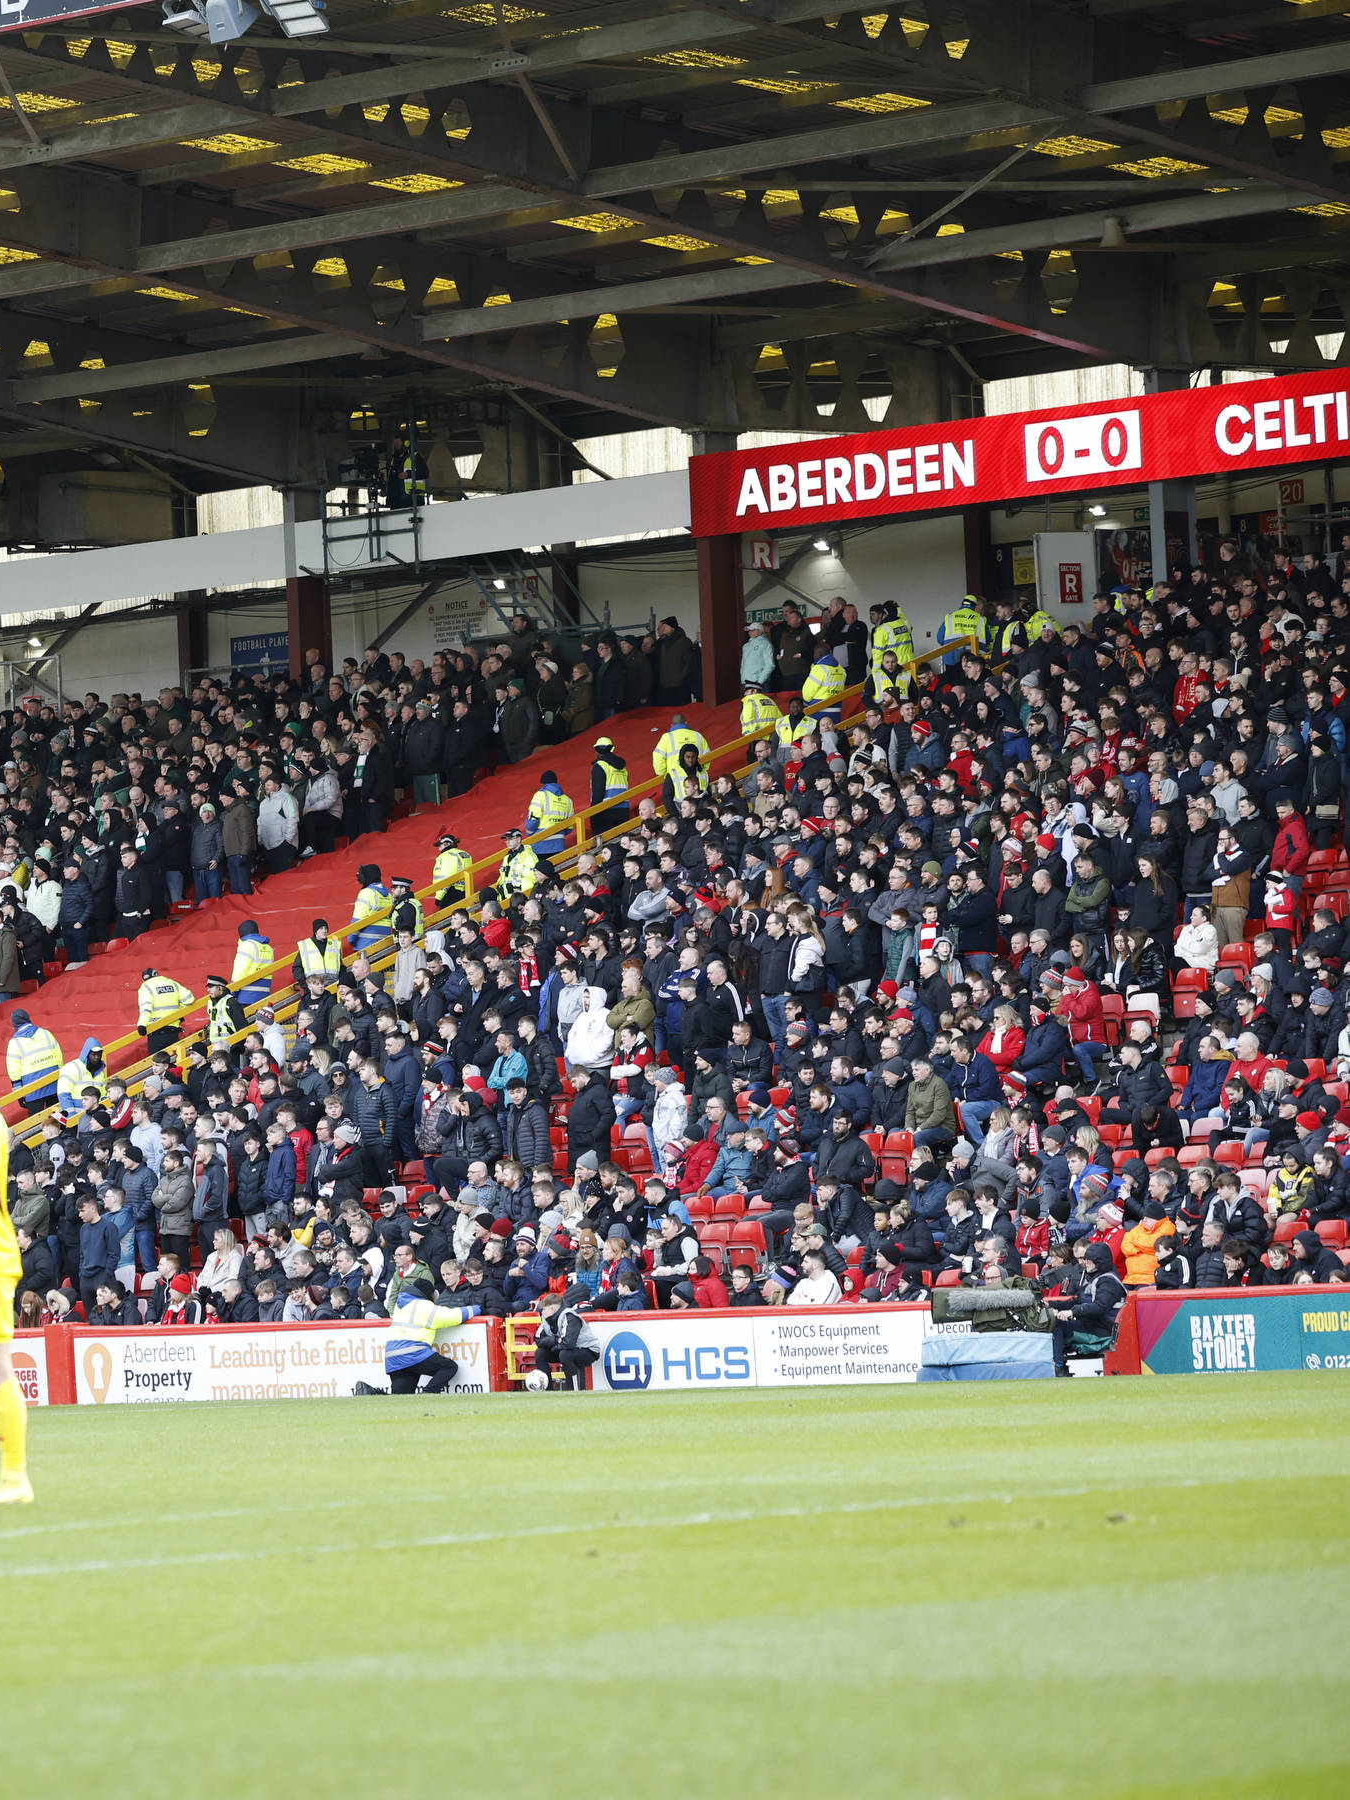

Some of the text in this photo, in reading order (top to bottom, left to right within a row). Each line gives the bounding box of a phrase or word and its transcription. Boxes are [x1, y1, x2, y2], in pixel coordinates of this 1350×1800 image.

[735, 439, 976, 517] ABERDEEN
[1214, 391, 1350, 456] CELTI
[1281, 483, 1302, 503] 20
[753, 541, 772, 568] R
[1065, 574, 1077, 593] R
[445, 600, 469, 610] NOTICE
[233, 638, 267, 652] FOOTBALL
[156, 986, 175, 994] POLICE
[778, 1324, 880, 1340] IWOCS Equipment
[1190, 1314, 1255, 1342] BAXTER
[1302, 1311, 1339, 1333] PROUD
[123, 1342, 196, 1363] Aberdeen
[209, 1342, 285, 1373] Leading
[290, 1341, 321, 1366] the
[324, 1339, 367, 1365] field
[780, 1343, 888, 1360] Manpower Services
[1192, 1334, 1256, 1369] STOREY
[662, 1346, 750, 1380] HCS
[781, 1361, 918, 1379] Equipment Maintenance
[123, 1369, 192, 1392] Property
